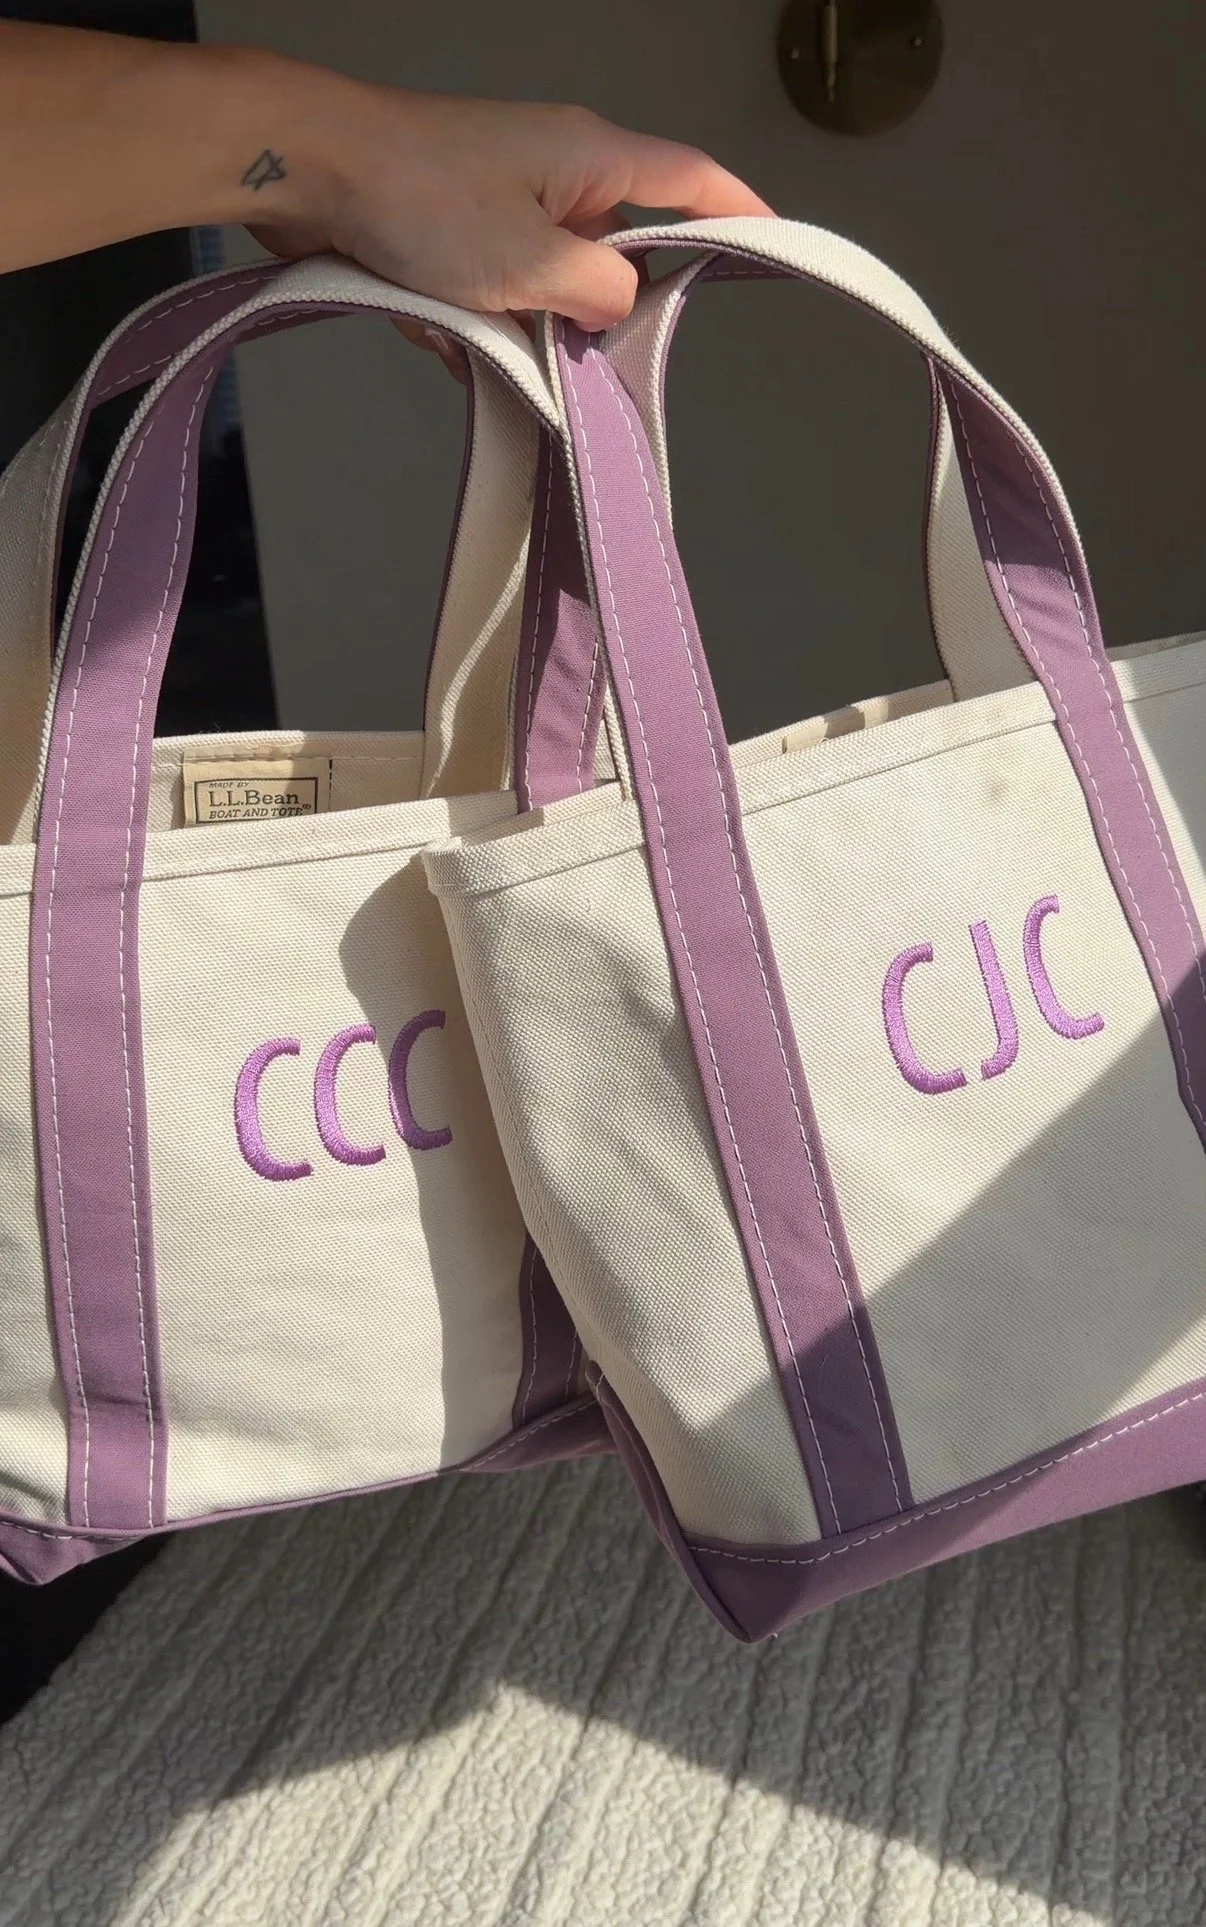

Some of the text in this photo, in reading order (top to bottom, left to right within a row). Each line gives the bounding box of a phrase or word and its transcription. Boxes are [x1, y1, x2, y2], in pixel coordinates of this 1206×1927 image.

[208, 789, 300, 807] L.L.Bean
[208, 809, 241, 820] BOAT
[242, 807, 268, 817] AND
[880, 894, 1105, 1096] CJC
[233, 1009, 453, 1182] CCC
